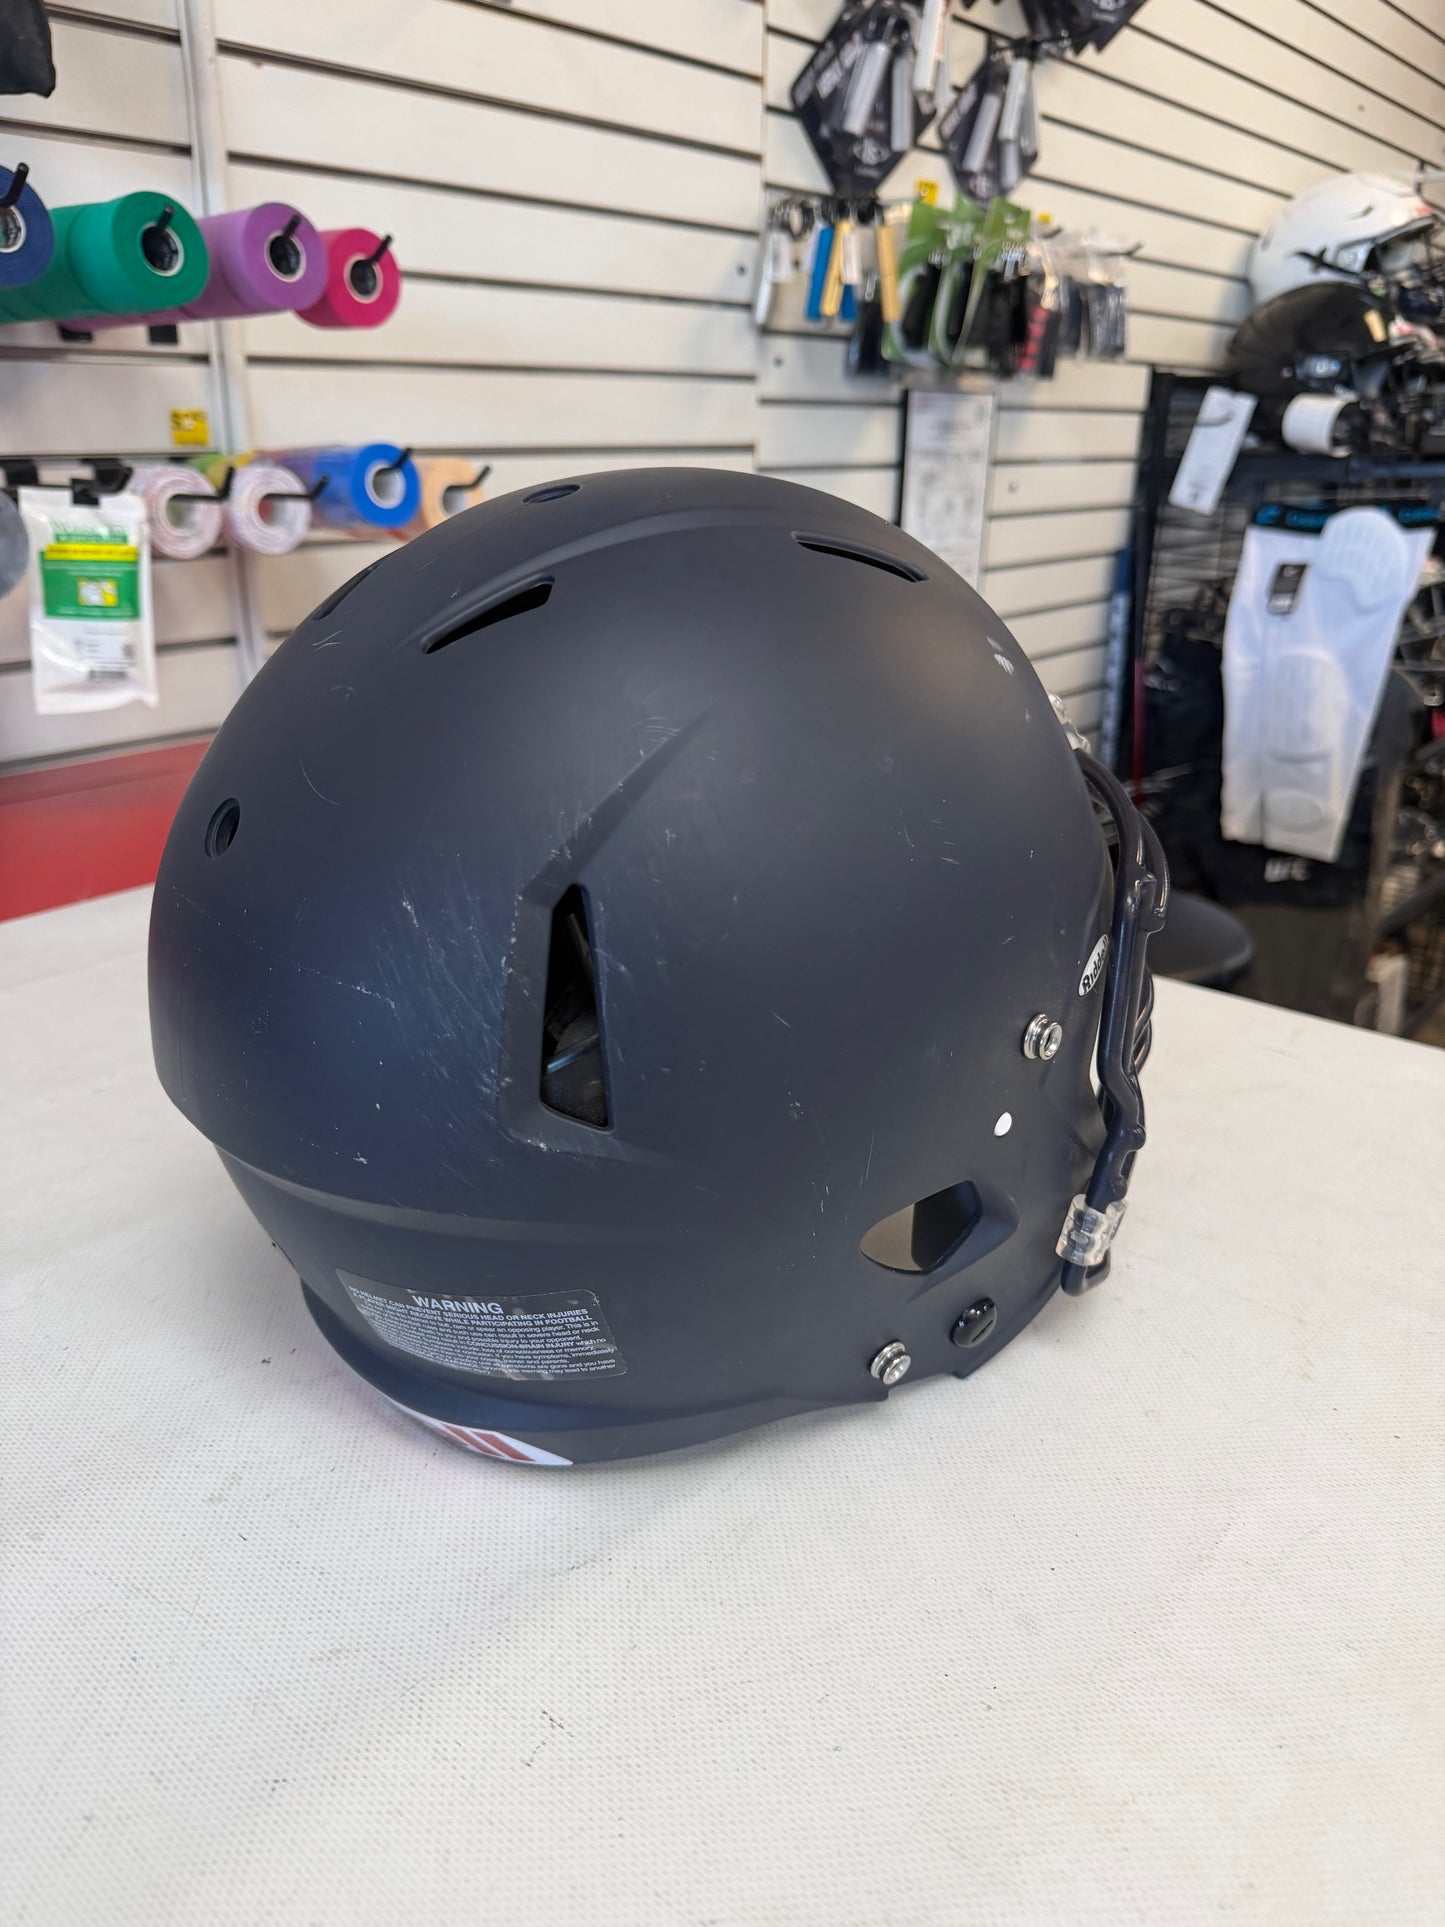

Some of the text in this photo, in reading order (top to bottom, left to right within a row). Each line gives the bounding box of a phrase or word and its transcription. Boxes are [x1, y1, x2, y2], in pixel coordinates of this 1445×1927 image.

[389, 1300, 405, 1308] CAN
[405, 1304, 441, 1315] PREVENT
[442, 1311, 480, 1320] SERIOUS
[520, 1313, 546, 1321] NECK
[546, 1308, 589, 1319] INJURIES
[412, 1295, 504, 1314] WARNING
[443, 1316, 470, 1325] WHILE
[470, 1319, 532, 1327] PARTICIPATING
[545, 1341, 574, 1349] INJURY
